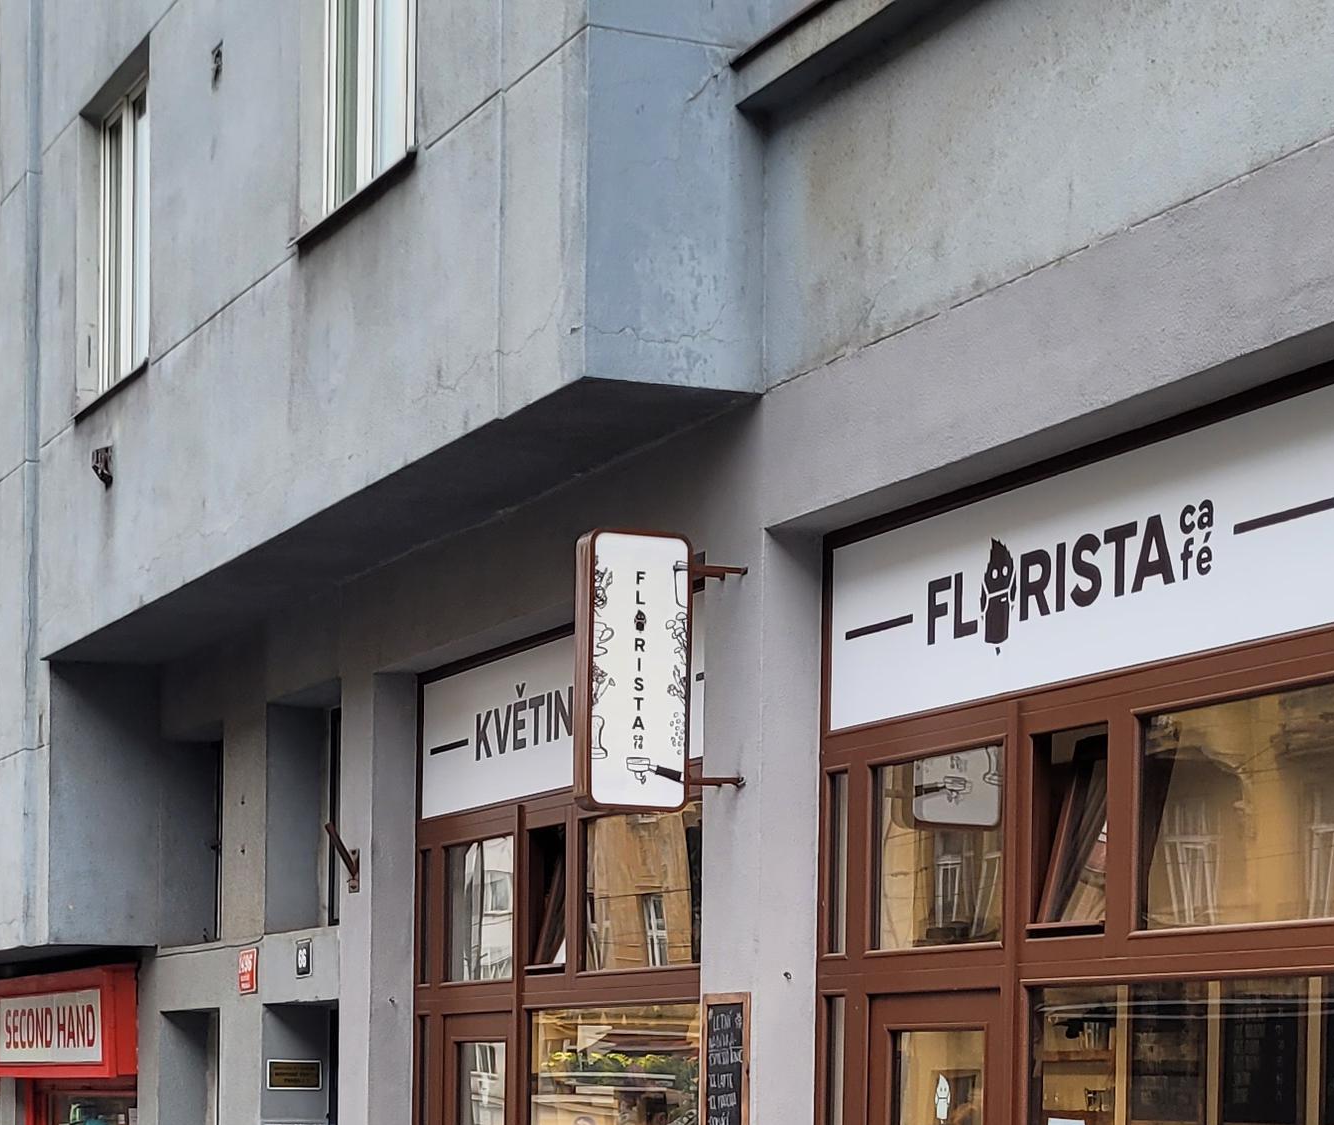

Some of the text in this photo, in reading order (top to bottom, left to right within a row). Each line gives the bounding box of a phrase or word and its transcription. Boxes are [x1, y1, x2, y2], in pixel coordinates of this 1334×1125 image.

[1179, 496, 1216, 533] ca
[1179, 533, 1214, 584] fé
[5, 1003, 96, 1050] SECOND HAND
